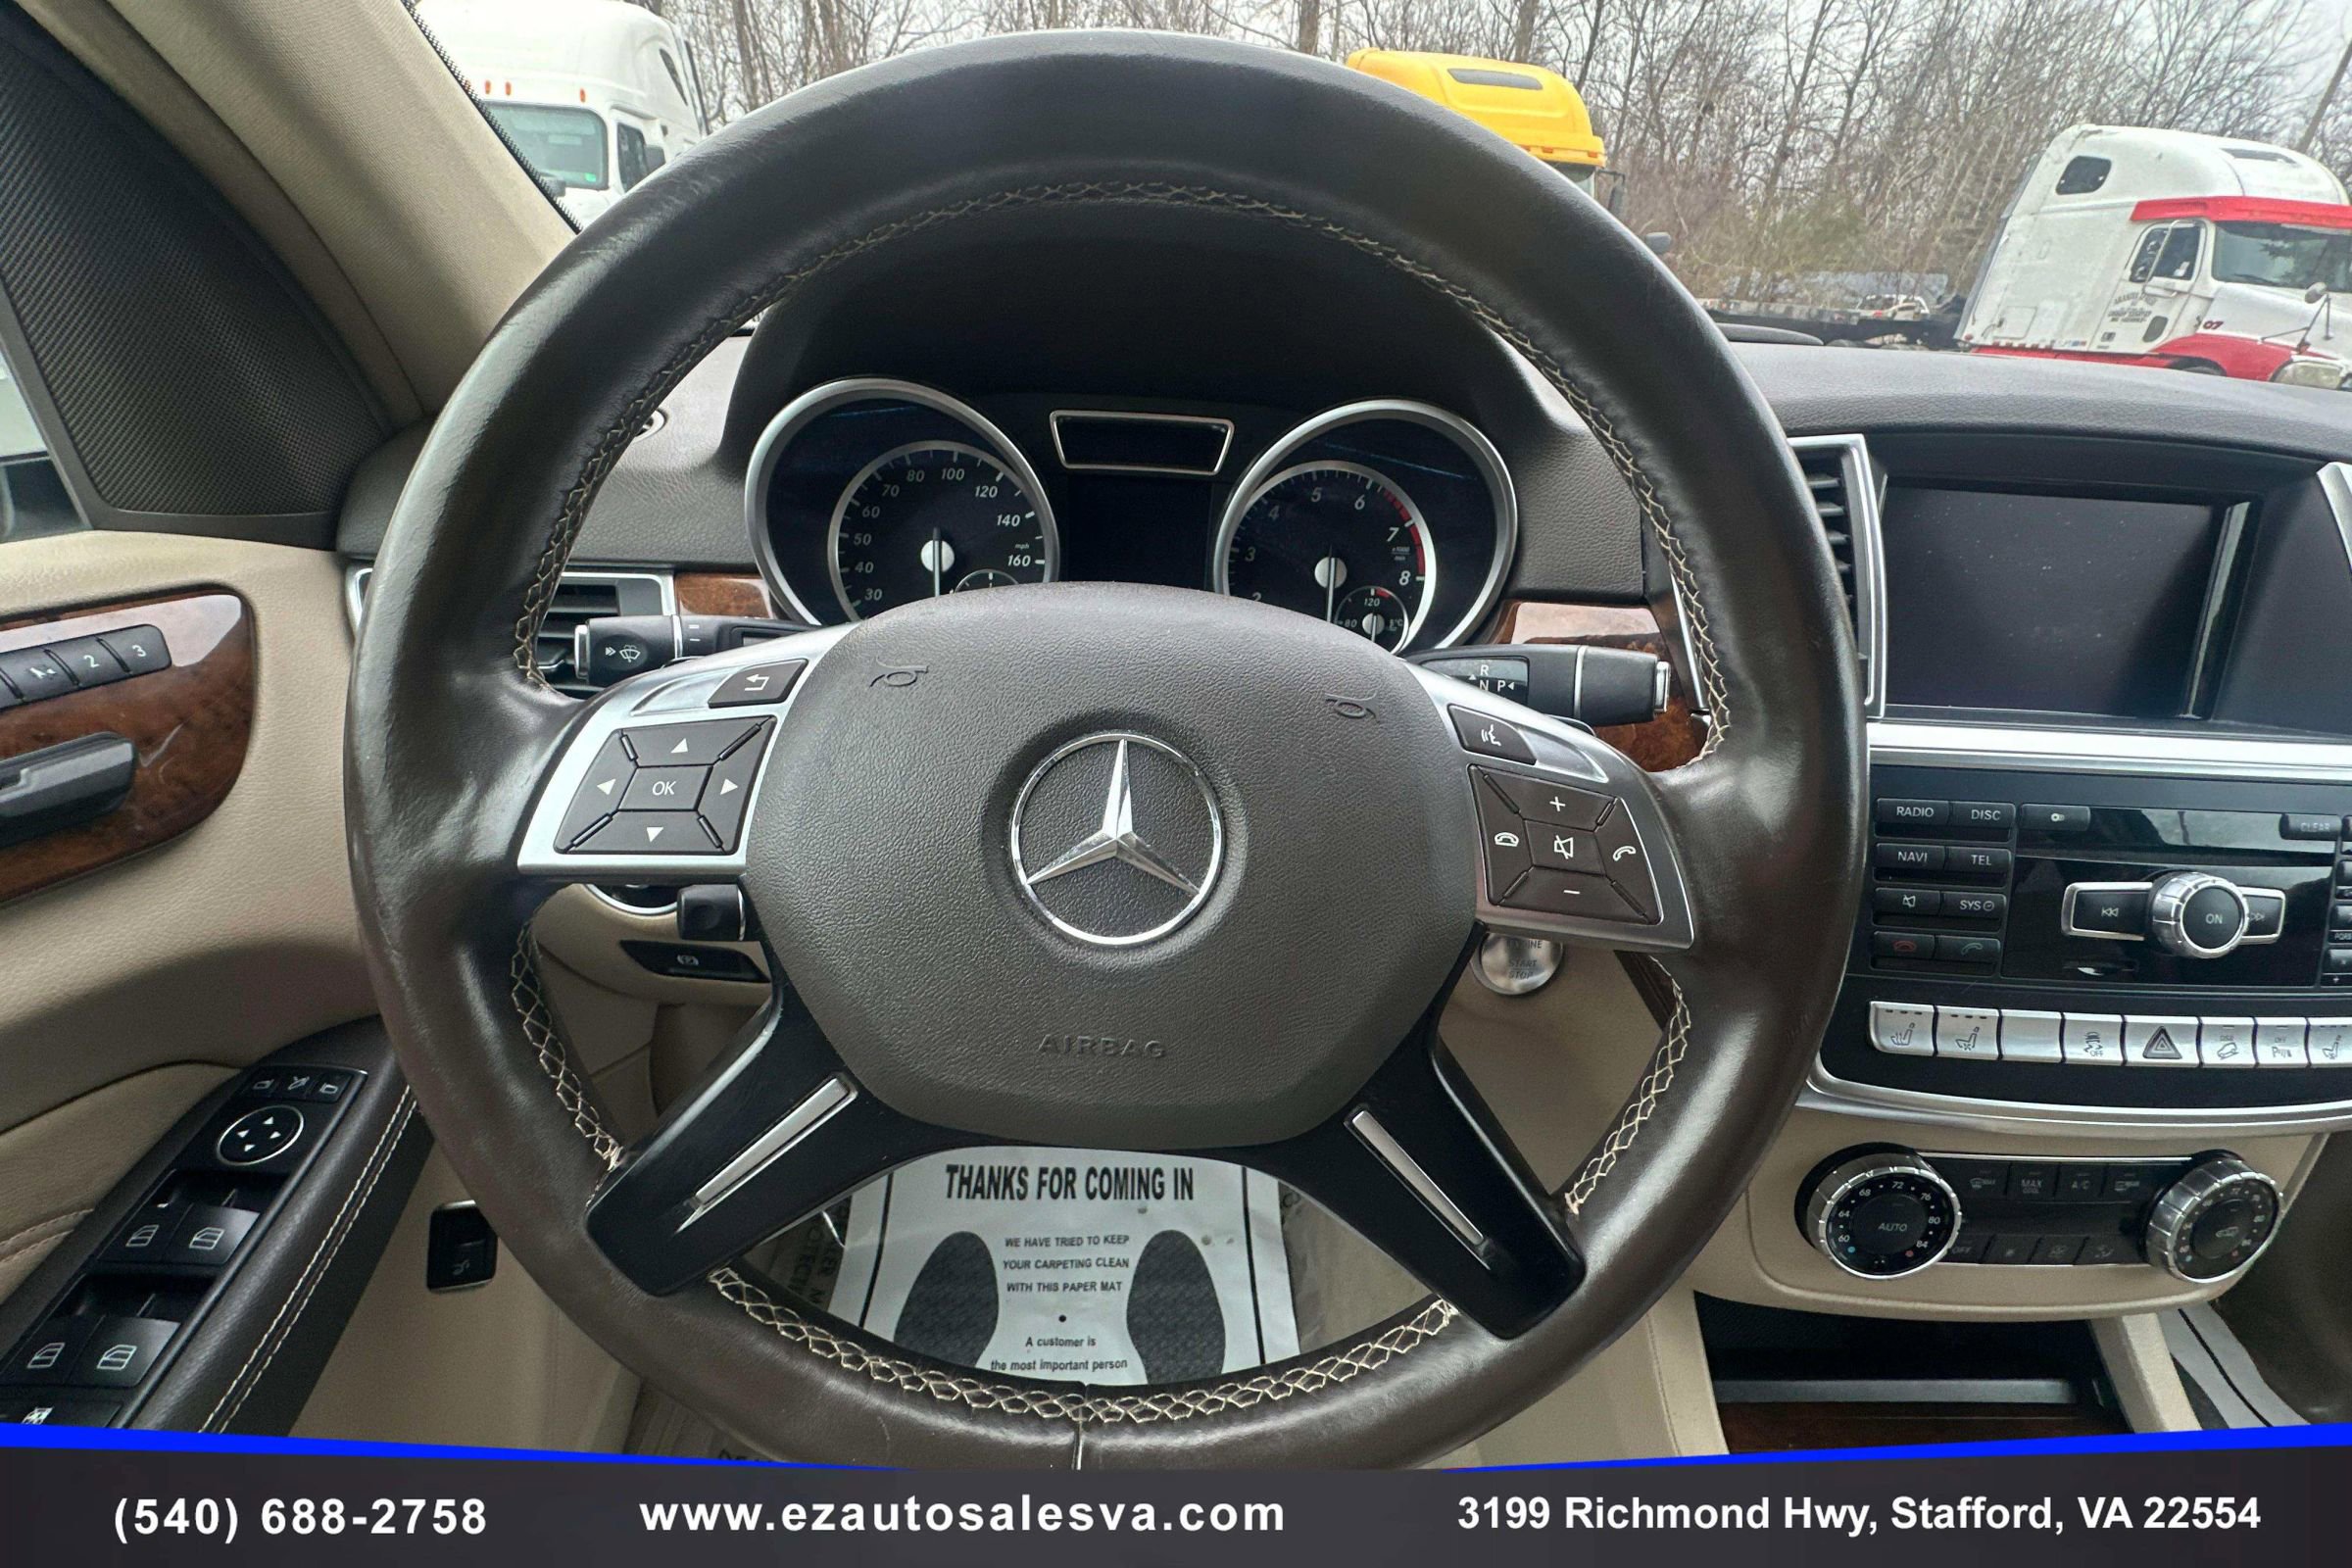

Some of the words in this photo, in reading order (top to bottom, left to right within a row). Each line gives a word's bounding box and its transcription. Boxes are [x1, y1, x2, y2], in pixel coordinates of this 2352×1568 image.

[906, 469, 925, 482] 80
[941, 467, 965, 481] 100
[883, 484, 900, 497] 70
[974, 485, 999, 498] 120
[1310, 487, 1323, 503] 5
[1354, 495, 1365, 510] 6
[862, 506, 880, 518] 60
[1268, 506, 1280, 520] 4
[997, 514, 1021, 527] 140
[854, 533, 872, 546] 50
[1387, 527, 1398, 542] 7
[1007, 555, 1031, 566] 160
[1245, 547, 1256, 562] 3
[855, 562, 874, 573] 40
[1399, 570, 1411, 586] 8
[864, 588, 882, 601] 30
[1364, 598, 1380, 607] 120
[1345, 619, 1357, 628] 80
[132, 645, 147, 658] 3
[83, 655, 99, 668] 2
[1480, 664, 1489, 675] R
[1480, 680, 1489, 691] N
[1497, 680, 1506, 691] P
[652, 781, 676, 796] OK
[1896, 806, 1935, 817] RADIO
[1971, 809, 2001, 821] DISC
[2300, 822, 2330, 832] CLEAR
[1897, 851, 1928, 862] NAVI
[1971, 854, 1992, 866] TEL
[1960, 900, 1981, 910] SYS
[2205, 912, 2223, 925] ON
[1038, 1034, 1166, 1058] AIRBAG
[946, 1164, 1028, 1200] THANKS
[1037, 1166, 1077, 1200] FOR
[1085, 1166, 1165, 1200] COMING
[1174, 1167, 1194, 1200] IN
[1892, 1181, 1904, 1190] 72
[1859, 1188, 1871, 1197] 68
[1920, 1192, 1932, 1200] 76
[1838, 1209, 1850, 1218] 64
[1878, 1223, 1908, 1232] AUTO
[1004, 1237, 1020, 1248] WE
[1024, 1237, 1051, 1248] HAVE
[1055, 1237, 1083, 1247] TRIED
[1087, 1236, 1100, 1246] TO
[1103, 1235, 1129, 1245] KEEP
[1838, 1234, 1850, 1243] 60
[1916, 1240, 1929, 1249] 84
[1003, 1259, 1031, 1270] YOUR
[1034, 1258, 1092, 1269] CARPETING
[1096, 1257, 1129, 1268] CLEAN
[1006, 1282, 1033, 1293] WITH
[1037, 1282, 1059, 1293] THIS
[1062, 1282, 1097, 1292] PAPER
[1101, 1281, 1122, 1292] MAT
[1025, 1337, 1033, 1347] A
[1037, 1337, 1084, 1347] customer
[1087, 1336, 1097, 1347] is
[991, 1360, 1006, 1370] the
[1010, 1360, 1036, 1370] most
[1040, 1358, 1089, 1372] important
[1092, 1358, 1128, 1372] person
